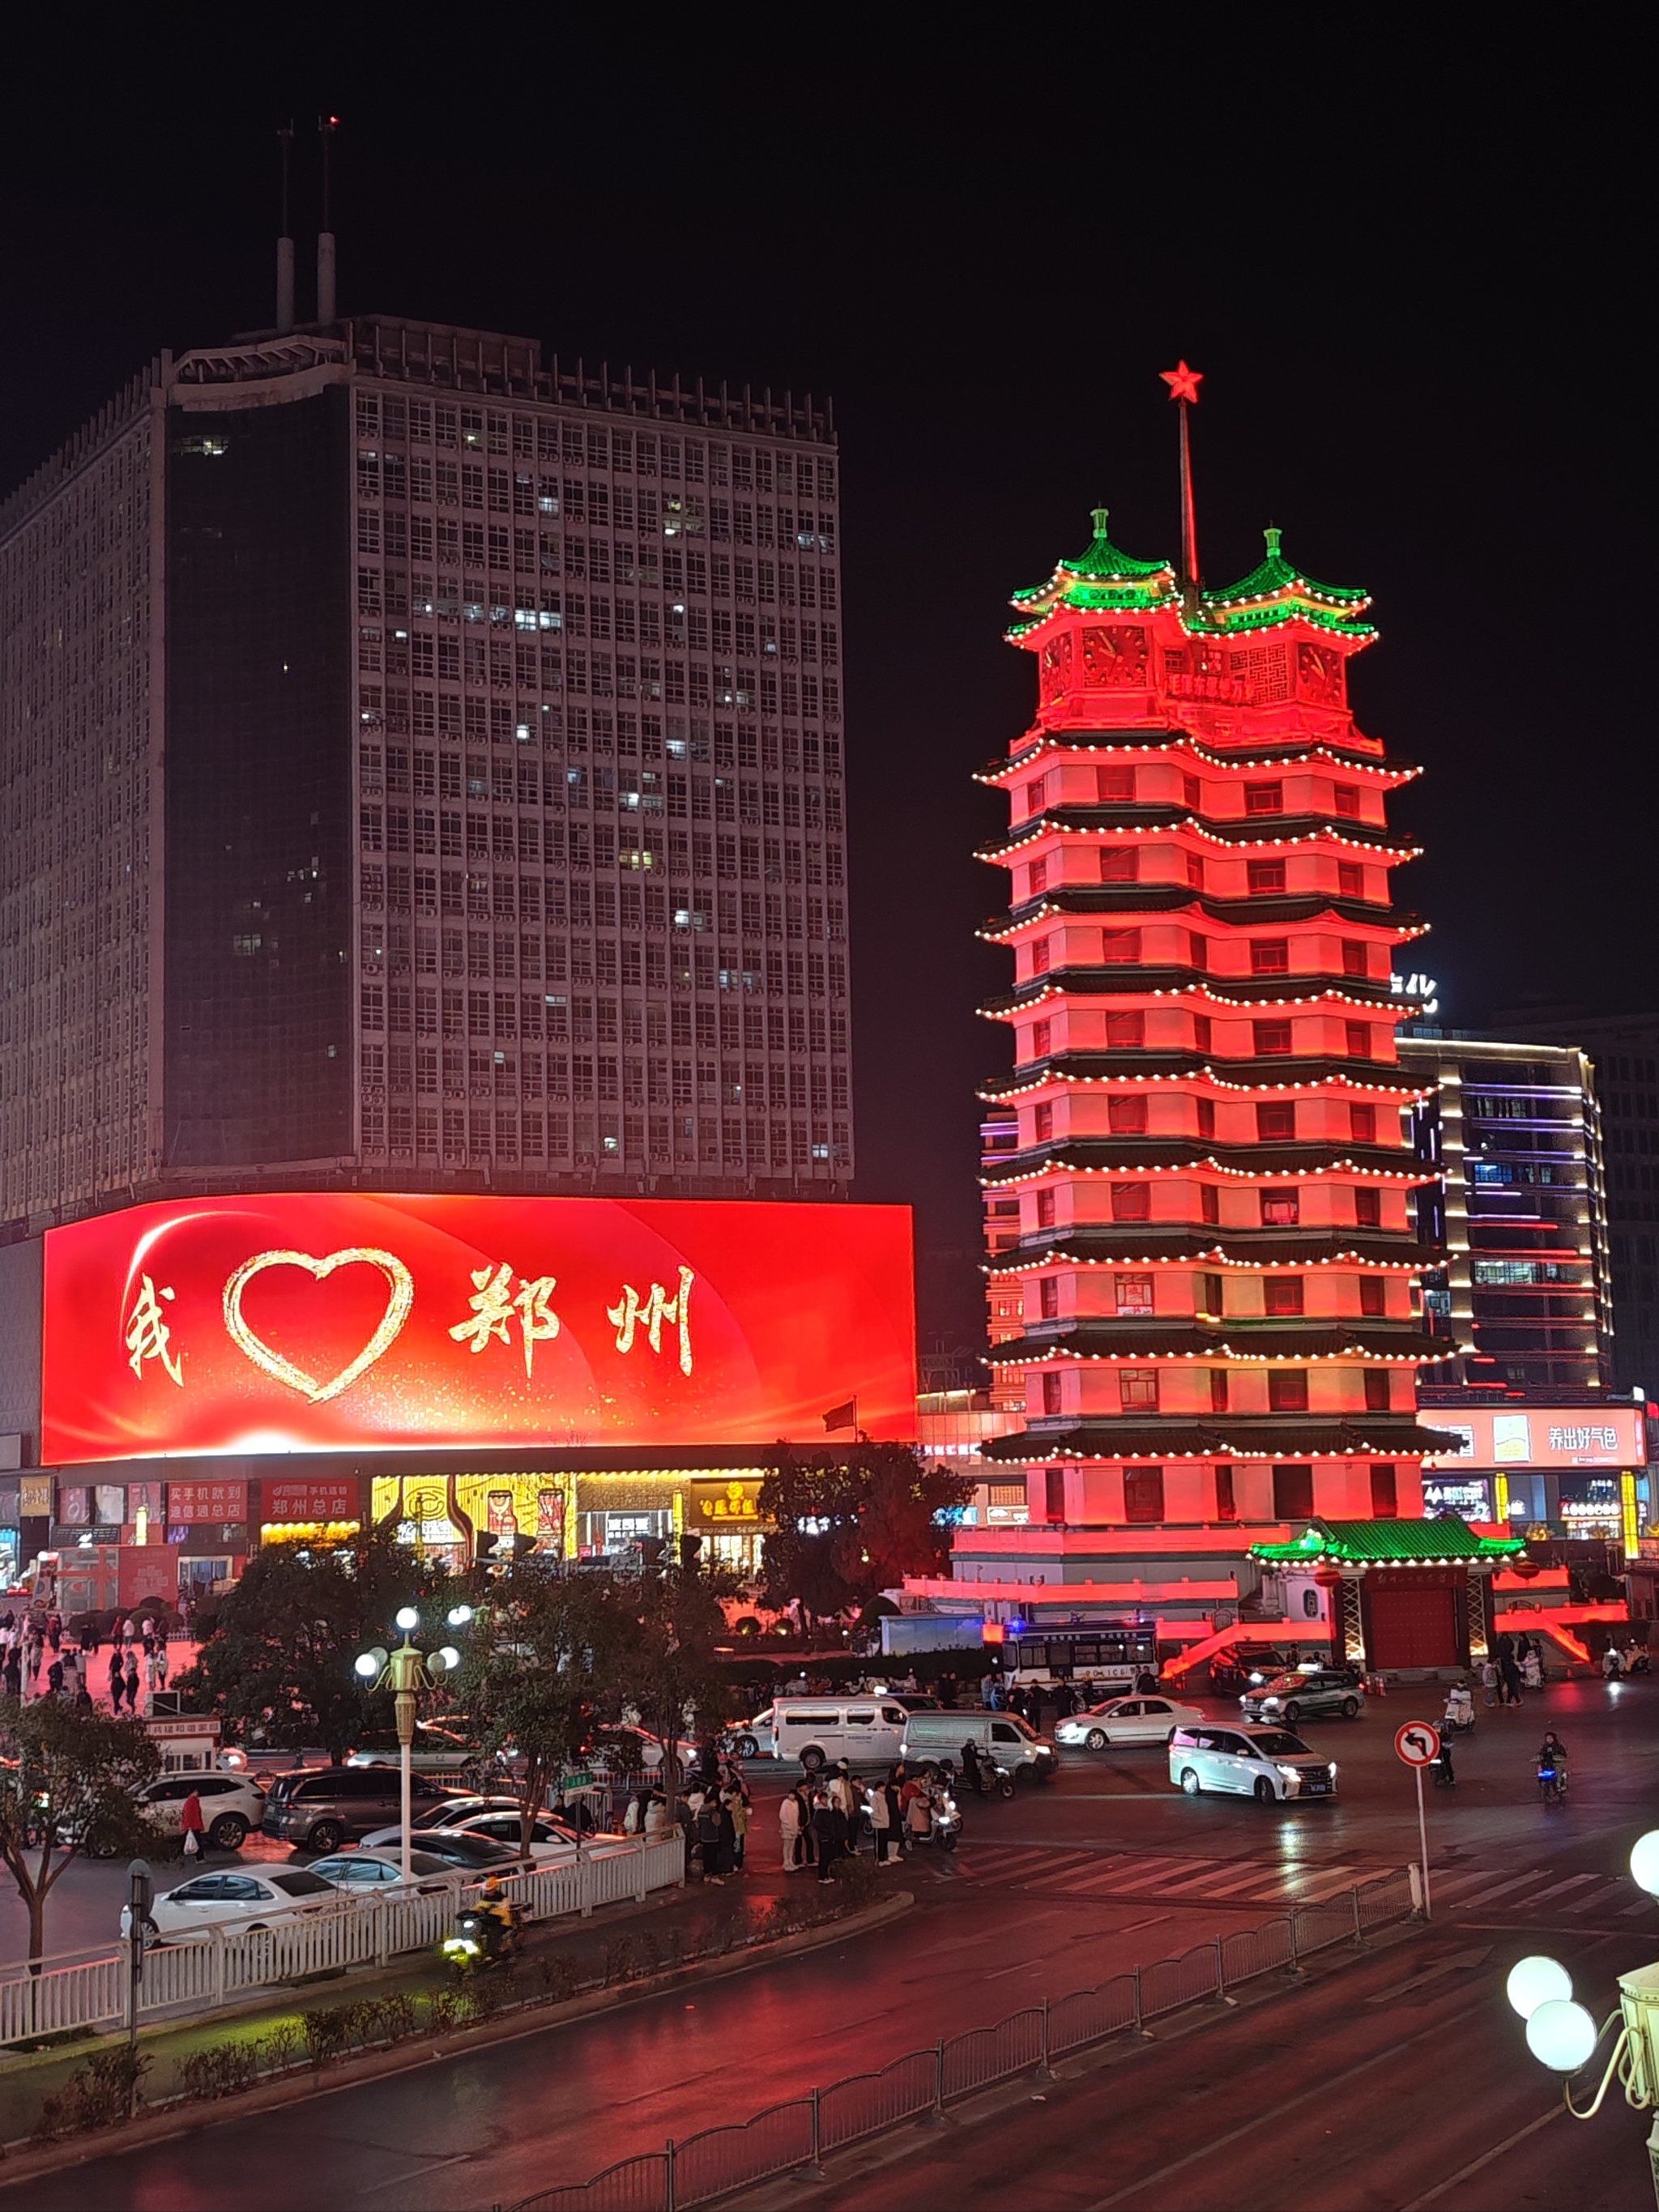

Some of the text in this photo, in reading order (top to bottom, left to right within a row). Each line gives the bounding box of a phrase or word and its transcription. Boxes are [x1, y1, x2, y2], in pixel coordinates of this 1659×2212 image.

[125, 1261, 694, 1387] 我 郑州
[1548, 1426, 1618, 1451] 养出好气色
[170, 1485, 241, 1501] 买手机就到
[170, 1504, 241, 1519] 迪信通总店
[272, 1498, 347, 1515] 郑州总店
[1086, 1669, 1125, 1677] POICE
